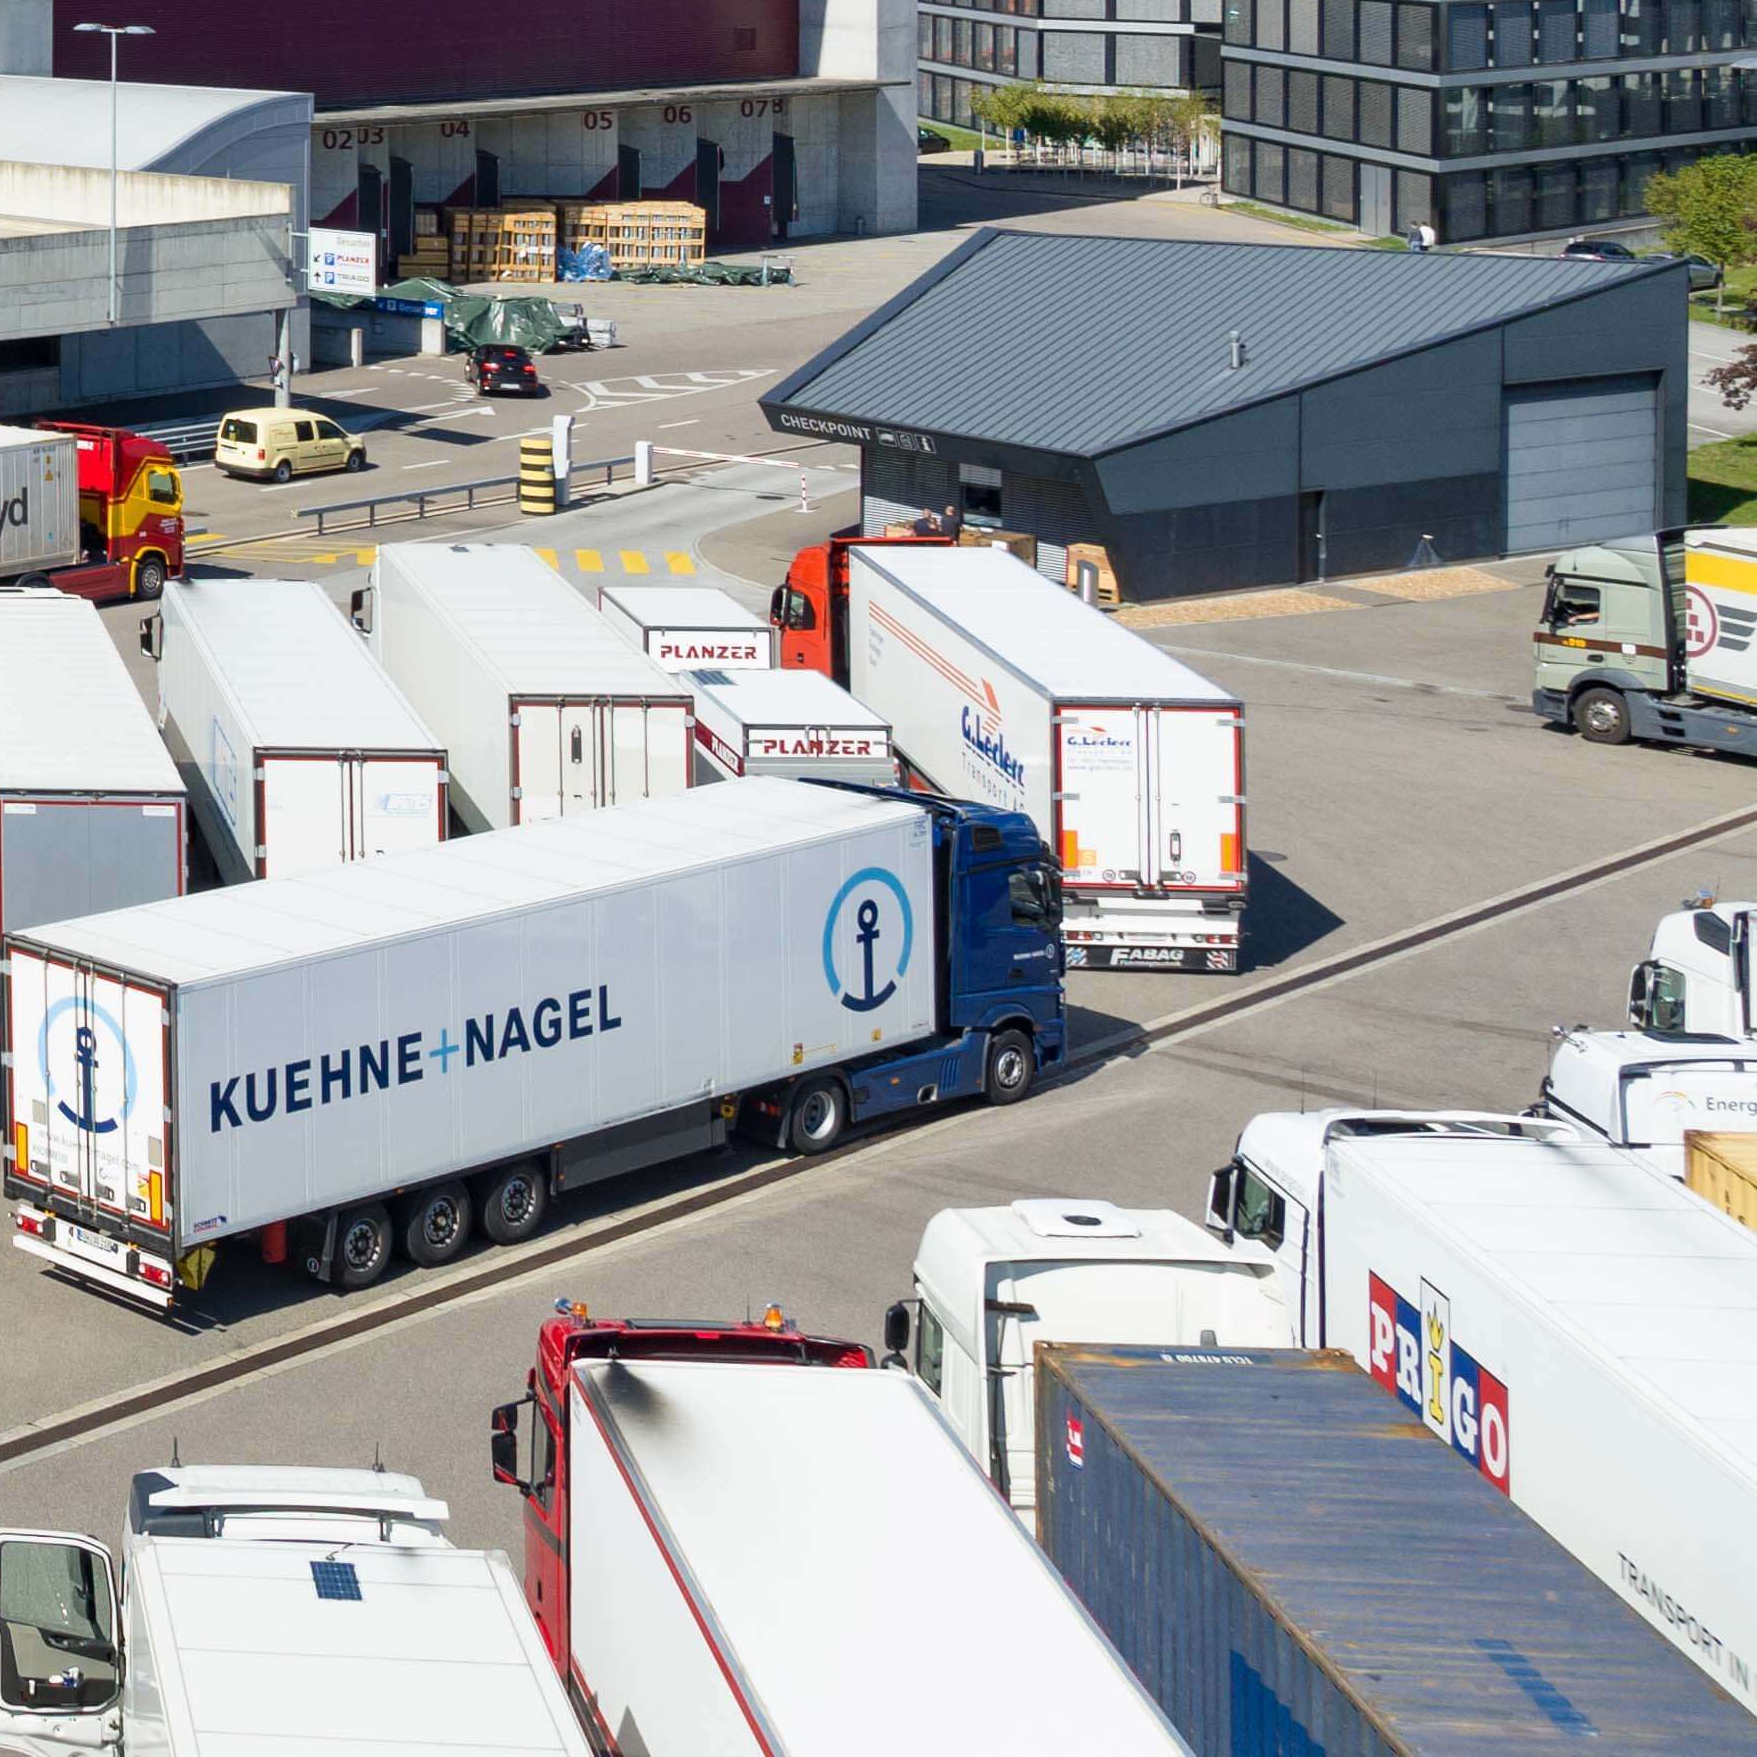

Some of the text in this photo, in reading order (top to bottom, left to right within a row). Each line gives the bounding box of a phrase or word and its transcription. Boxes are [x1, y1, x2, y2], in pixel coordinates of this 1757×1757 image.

[663, 105, 692, 124] 06
[741, 99, 768, 117] 07
[441, 121, 470, 138] 04
[583, 111, 613, 130] 05
[323, 130, 353, 150] 02
[337, 255, 370, 264] PLANZER
[780, 413, 871, 441] CHECKPOINT
[660, 645, 758, 660] PLANZER
[763, 739, 872, 756] PLANZER
[961, 704, 1025, 789] G.Leclerc
[1067, 735, 1133, 747] G.Leclerc
[961, 751, 1008, 808] Transport
[1110, 947, 1185, 966] FABAG
[1371, 1301, 1507, 1486] PRIGO
[1615, 1549, 1750, 1693] TRANSPORT IN
